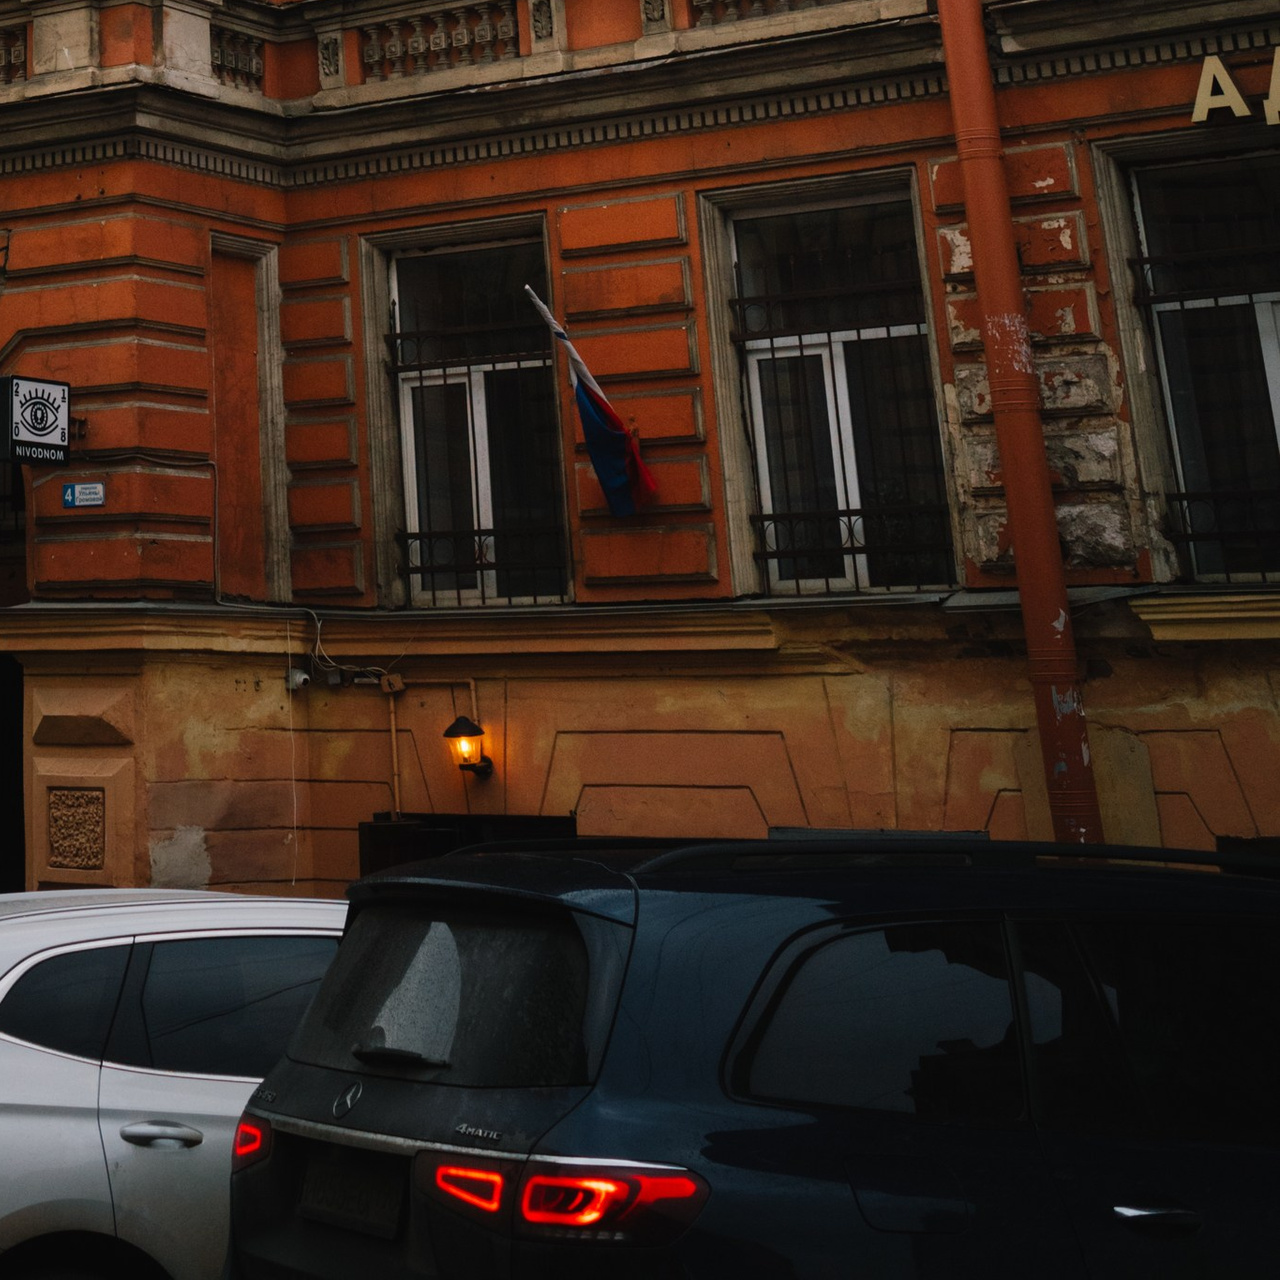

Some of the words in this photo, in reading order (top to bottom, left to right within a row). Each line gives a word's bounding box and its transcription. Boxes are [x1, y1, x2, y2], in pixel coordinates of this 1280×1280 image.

[16, 445, 65, 461] NIVODNOM
[64, 488, 72, 502] 4
[455, 1123, 500, 1140] 4MATIC
